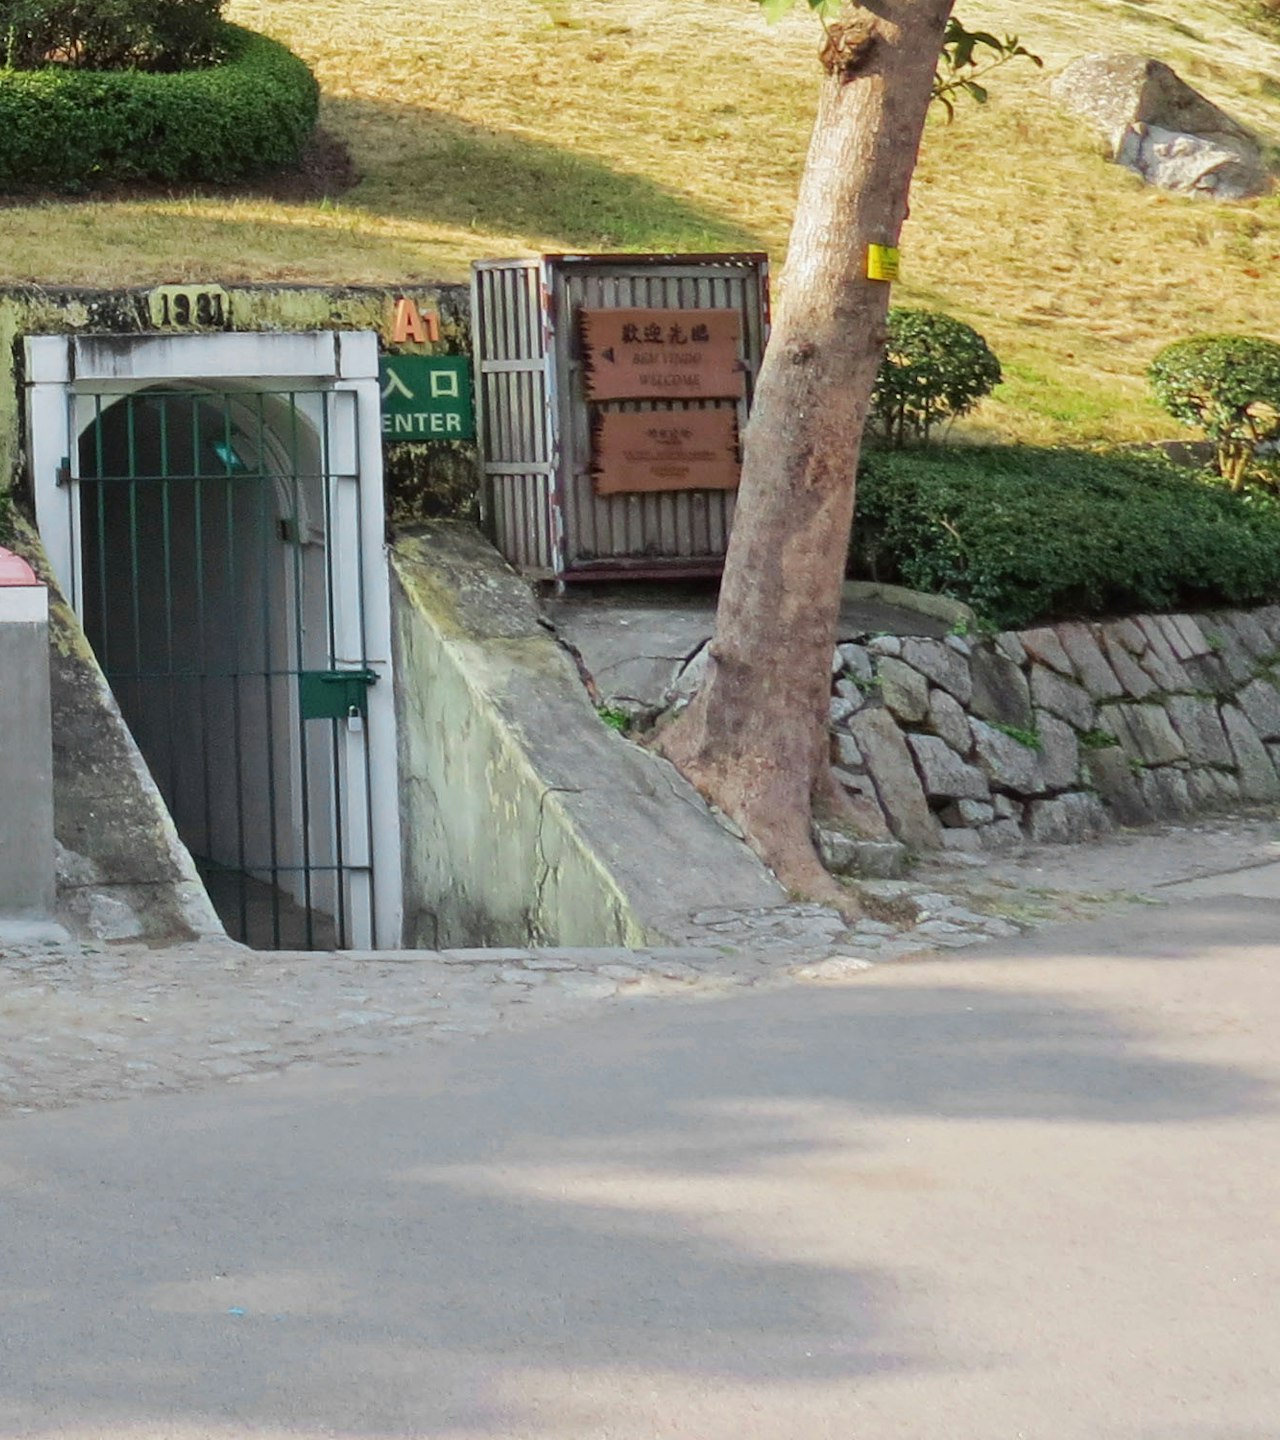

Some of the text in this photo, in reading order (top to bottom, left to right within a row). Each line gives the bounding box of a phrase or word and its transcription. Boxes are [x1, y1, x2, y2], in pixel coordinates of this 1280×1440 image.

[393, 298, 439, 343] A1
[622, 322, 710, 345] 歡迎光臨
[381, 367, 459, 399] 入口
[639, 374, 701, 387] WELCOME
[381, 413, 462, 433] ENTER
